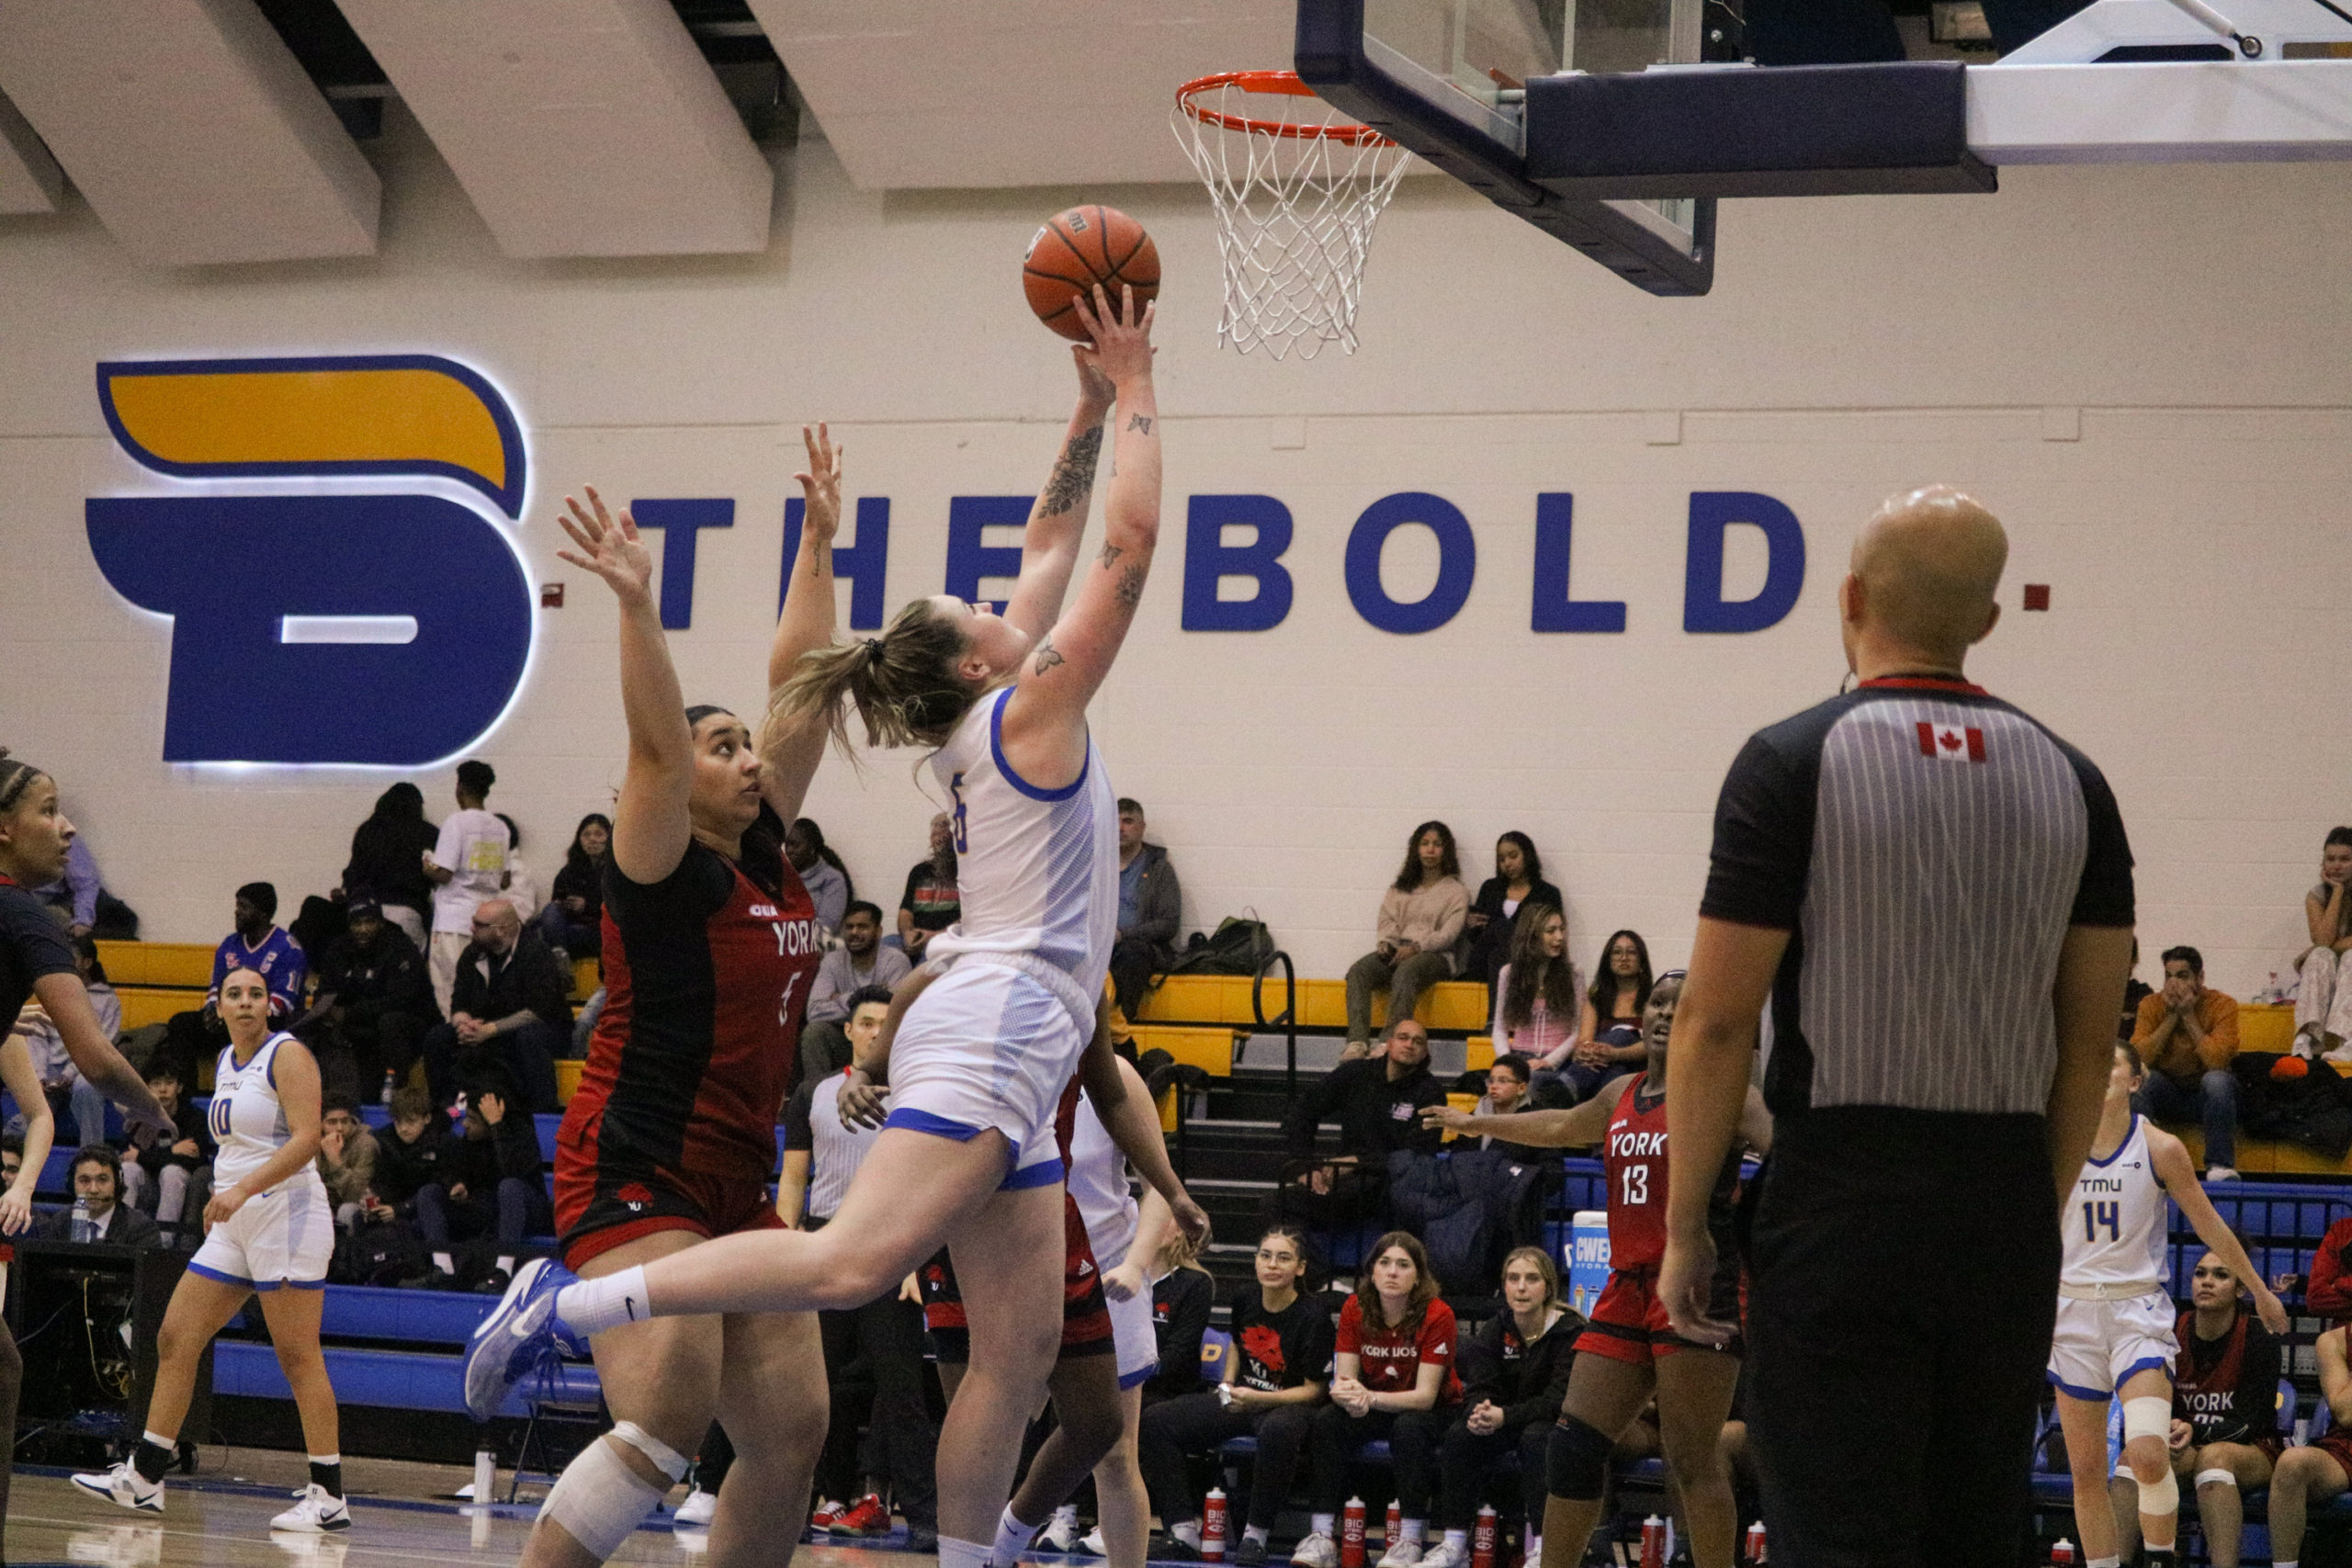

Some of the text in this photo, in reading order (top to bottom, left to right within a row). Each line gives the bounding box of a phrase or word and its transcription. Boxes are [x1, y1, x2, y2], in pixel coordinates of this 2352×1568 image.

[630, 491, 1806, 634] THE BOLD
[778, 971, 802, 1027] 5
[210, 1098, 232, 1137] 10
[1611, 1132, 1668, 1157] YORK
[1622, 1164, 1649, 1206] 13
[2079, 1179, 2122, 1192] TMU
[2083, 1201, 2120, 1244] 14
[1576, 1236, 1612, 1263] CWE
[1361, 1344, 1390, 1358] YORK
[2181, 1391, 2235, 1412] YORK
[1344, 1518, 1364, 1529] BIO
